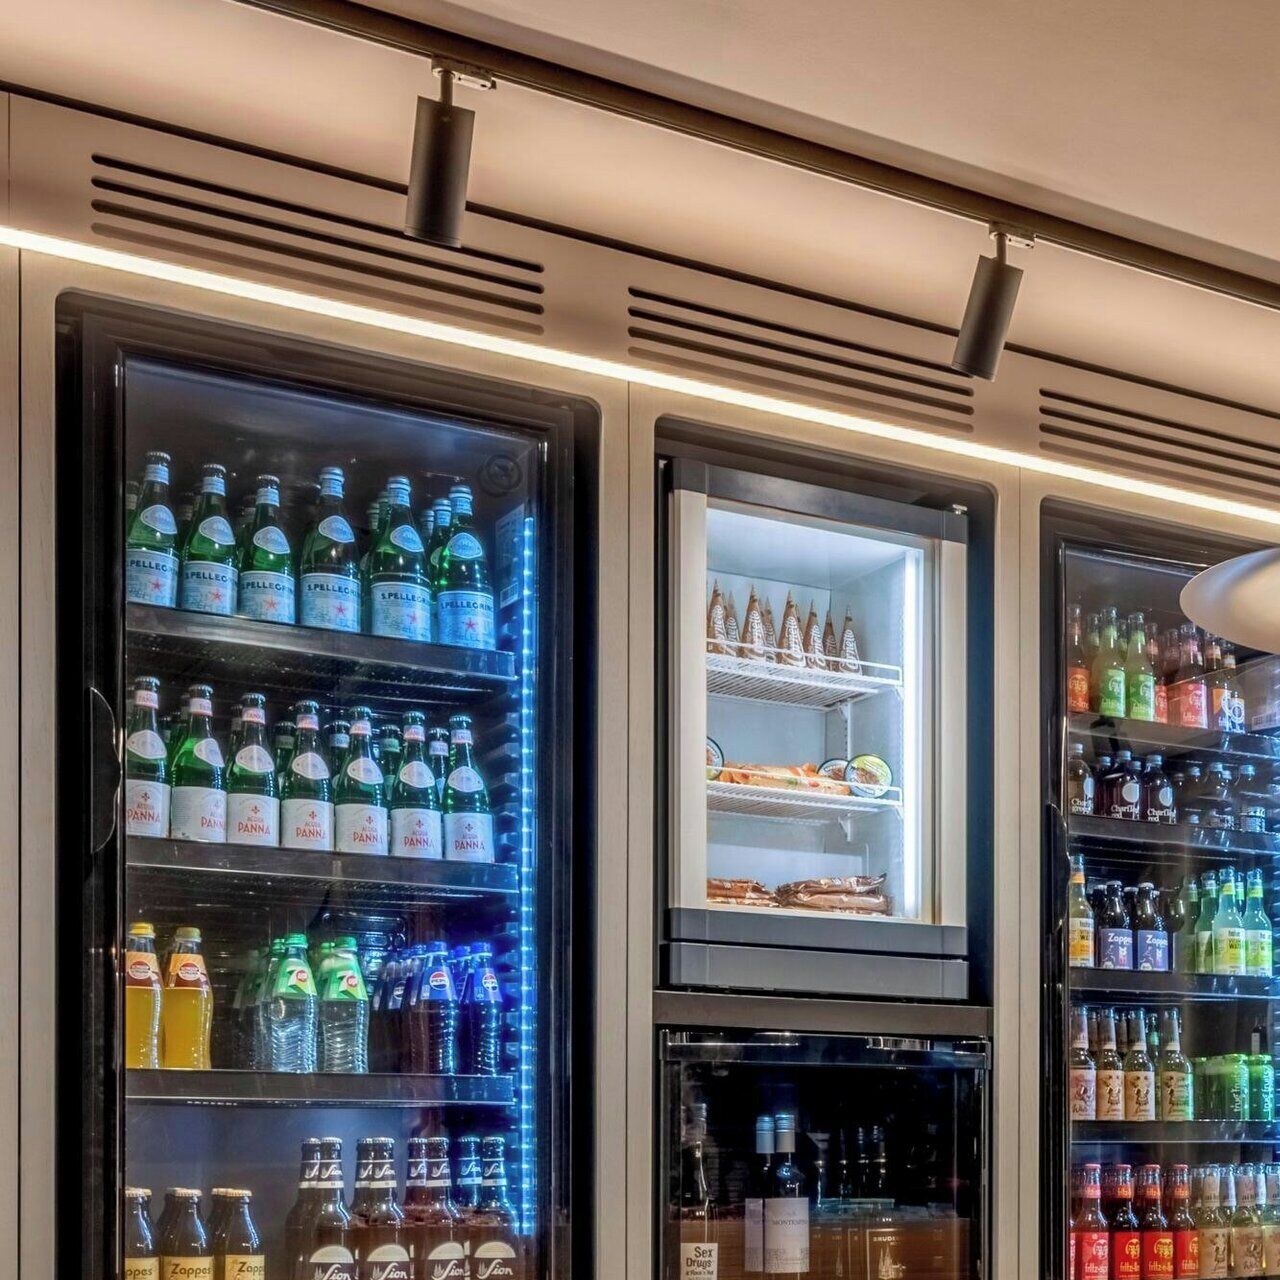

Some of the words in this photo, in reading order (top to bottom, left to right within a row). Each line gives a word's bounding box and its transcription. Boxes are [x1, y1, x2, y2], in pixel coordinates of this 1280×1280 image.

[693, 1245, 714, 1259] Sex
[171, 1263, 213, 1279] Zappes
[476, 1258, 514, 1280] Sion
[685, 1257, 712, 1270] Drugs
